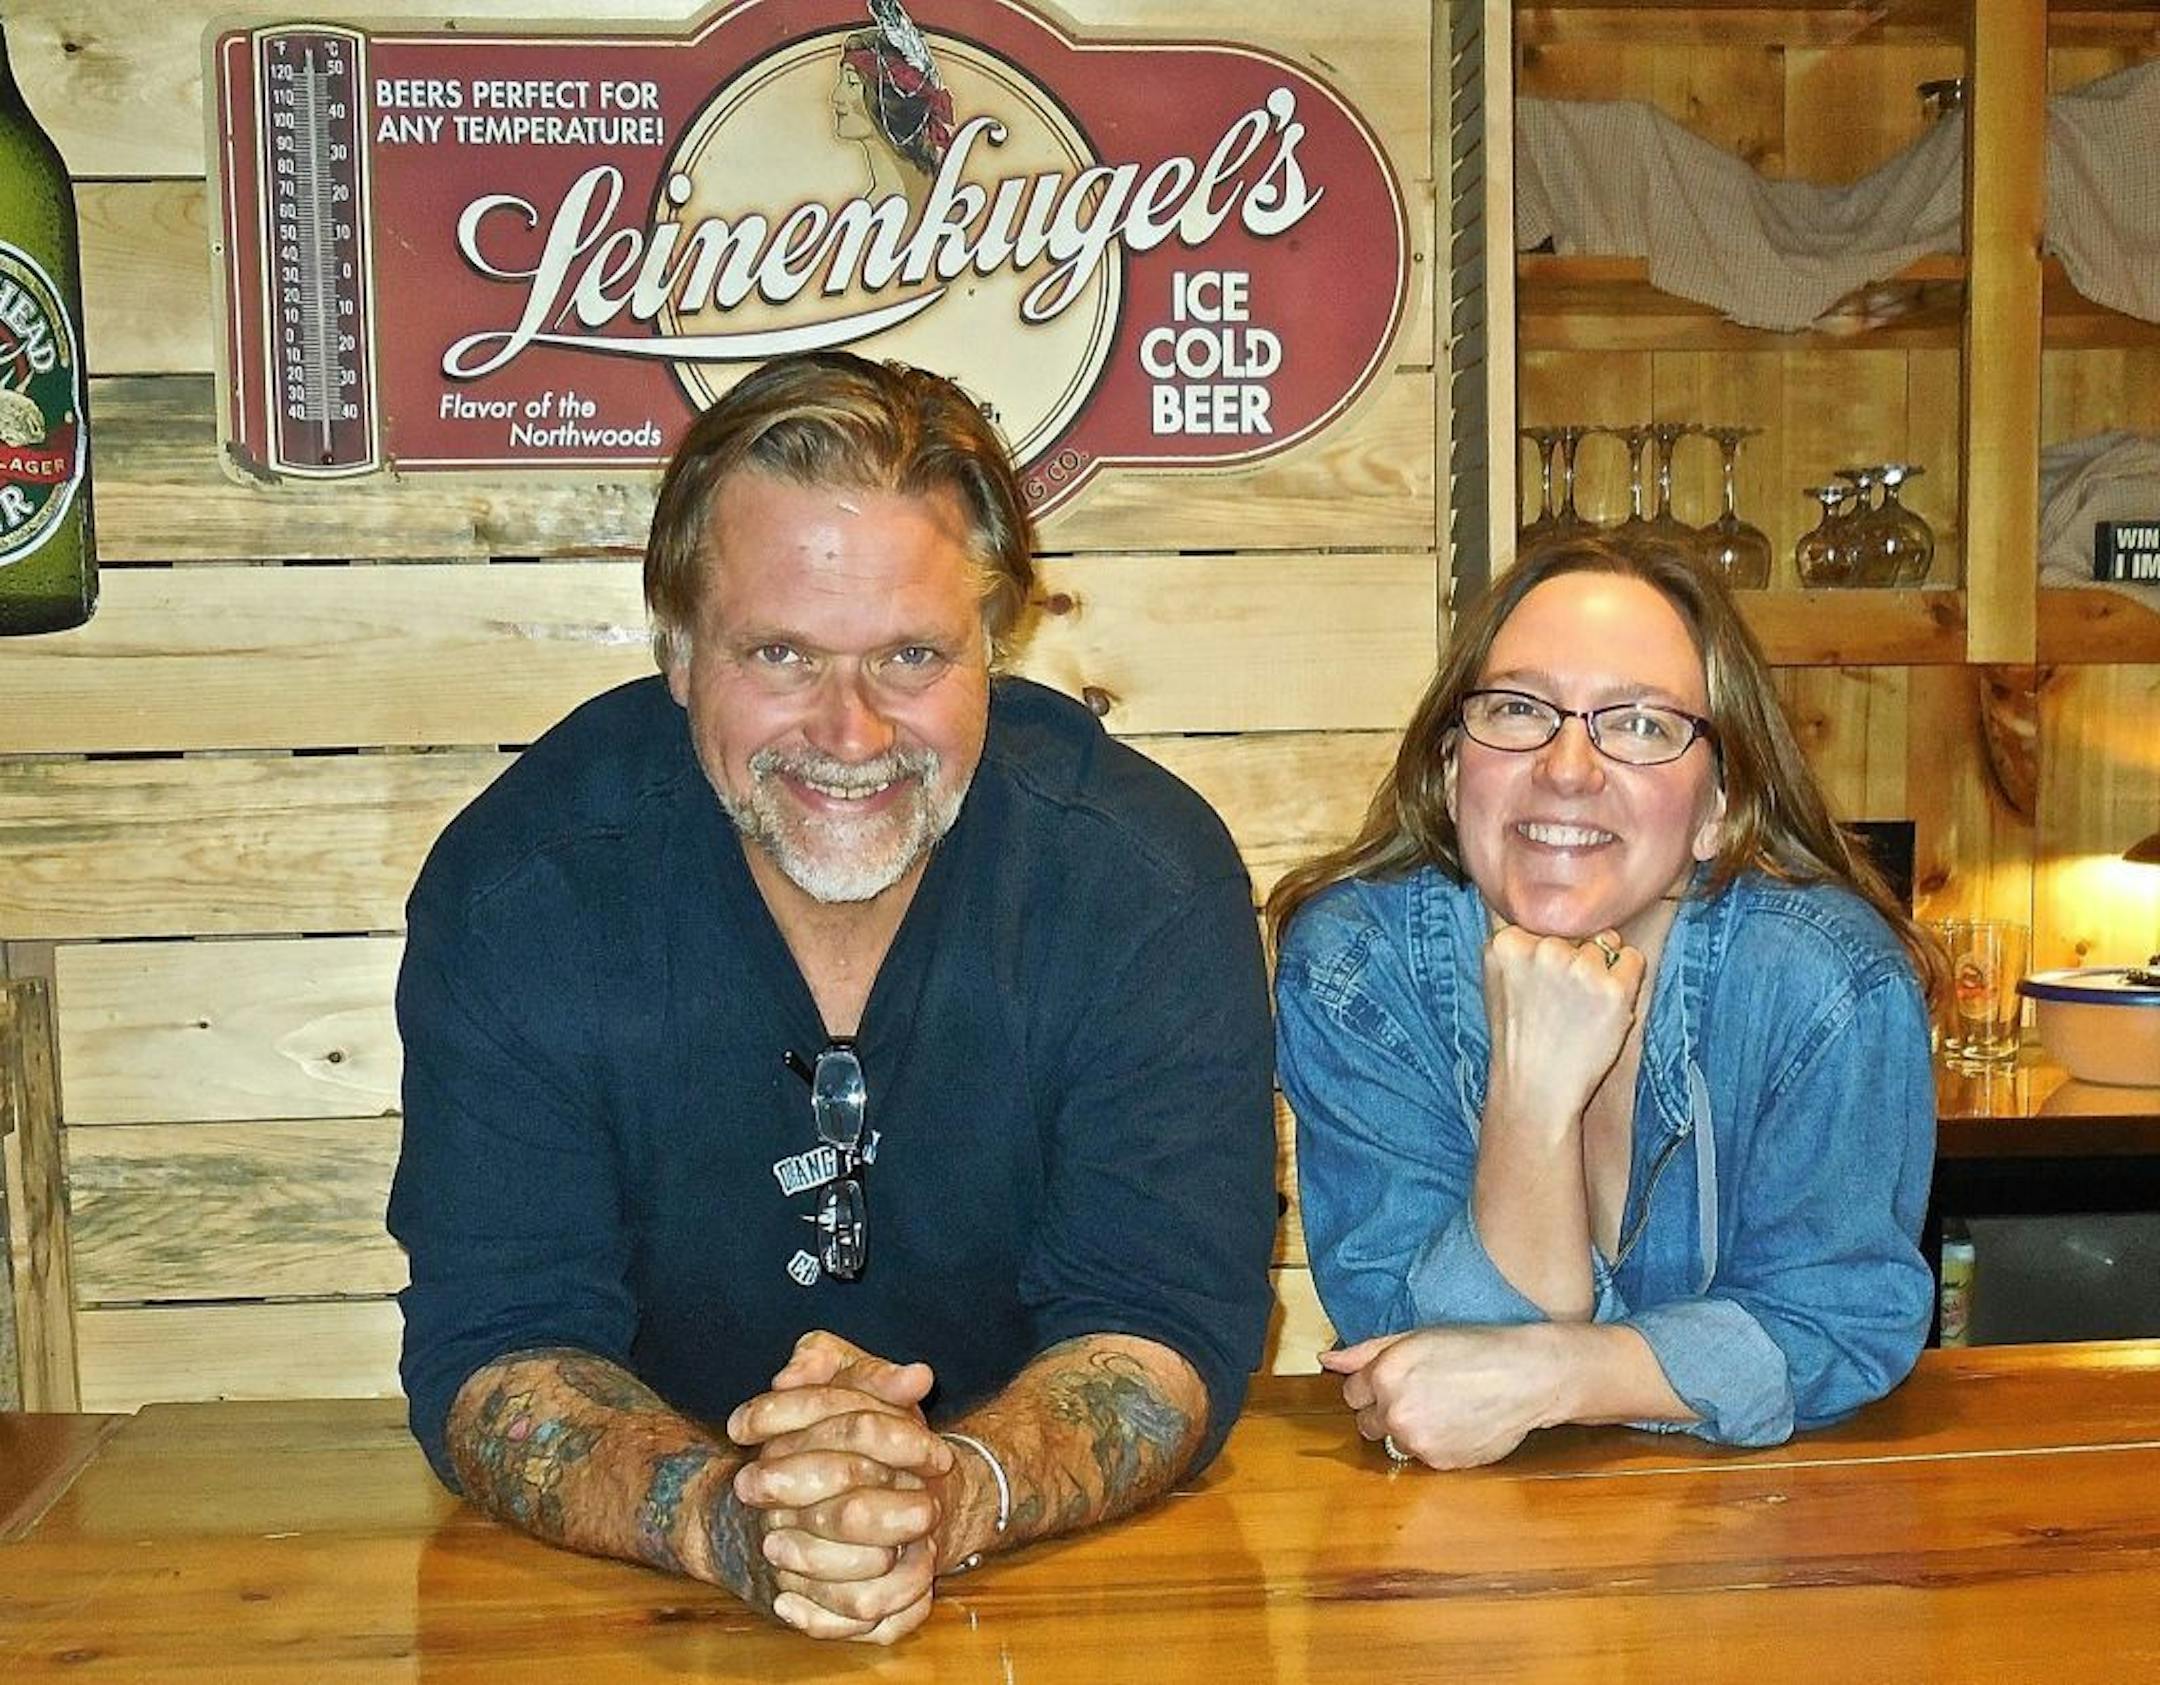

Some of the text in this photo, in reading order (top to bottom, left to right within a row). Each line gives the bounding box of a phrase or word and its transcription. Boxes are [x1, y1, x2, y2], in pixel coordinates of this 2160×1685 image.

[271, 64, 293, 80] 120
[327, 60, 343, 75] 50
[273, 89, 294, 107] 110
[376, 79, 659, 110] BEERS PERFECT FOR
[329, 103, 346, 119] 40
[273, 112, 294, 129] 100
[376, 115, 664, 145] ANY TEMPERATURE!
[276, 135, 294, 151] 90
[330, 144, 347, 160] 30
[277, 158, 295, 175] 80
[278, 180, 295, 197] 70
[332, 184, 350, 202] 20
[279, 203, 297, 219] 60
[280, 224, 297, 241] 50
[336, 223, 352, 240] 10
[441, 87, 1324, 378] Leinenkugel's
[281, 245, 299, 262] 40
[282, 266, 299, 283] 30
[342, 262, 352, 279] 0
[283, 287, 300, 304] 20
[1173, 271, 1250, 322] ICE
[284, 307, 299, 323] 10
[339, 299, 354, 315] 10
[285, 327, 295, 343] 0
[339, 335, 356, 352] 20
[286, 347, 300, 363] 10
[1140, 327, 1282, 379] COLD
[286, 365, 303, 382] 20
[287, 384, 305, 401] 30
[287, 403, 306, 420] 40
[342, 403, 358, 418] 40
[439, 391, 597, 419] Flavor of the
[1152, 384, 1273, 434] BEER
[509, 420, 662, 447] Northwoods
[1047, 449, 1090, 482] CO.
[2115, 553, 2126, 579] I
